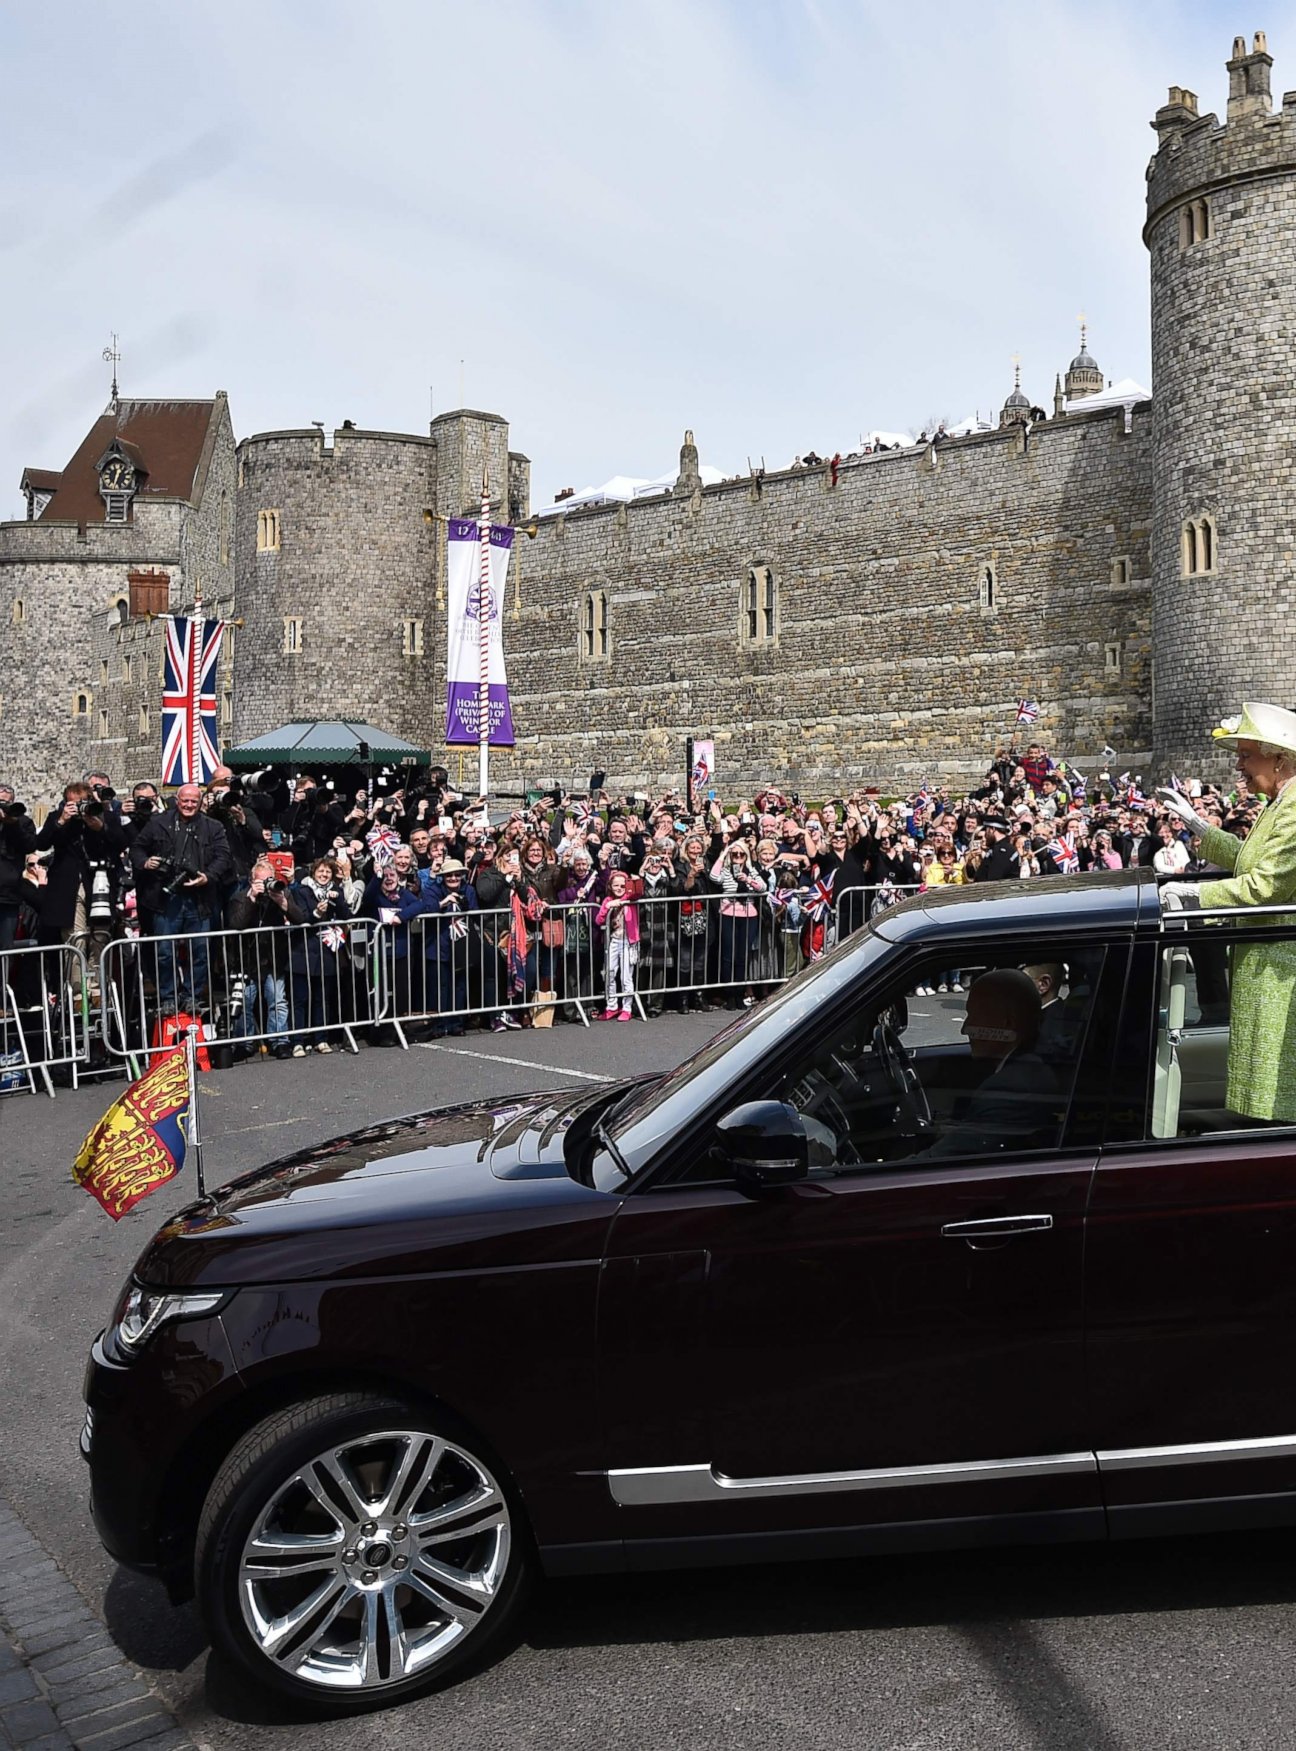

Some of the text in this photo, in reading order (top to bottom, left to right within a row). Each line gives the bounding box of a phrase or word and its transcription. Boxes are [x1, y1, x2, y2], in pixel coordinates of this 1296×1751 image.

[458, 526, 469, 535] 12
[494, 710, 506, 718] OF
[460, 716, 501, 726] WINOR
